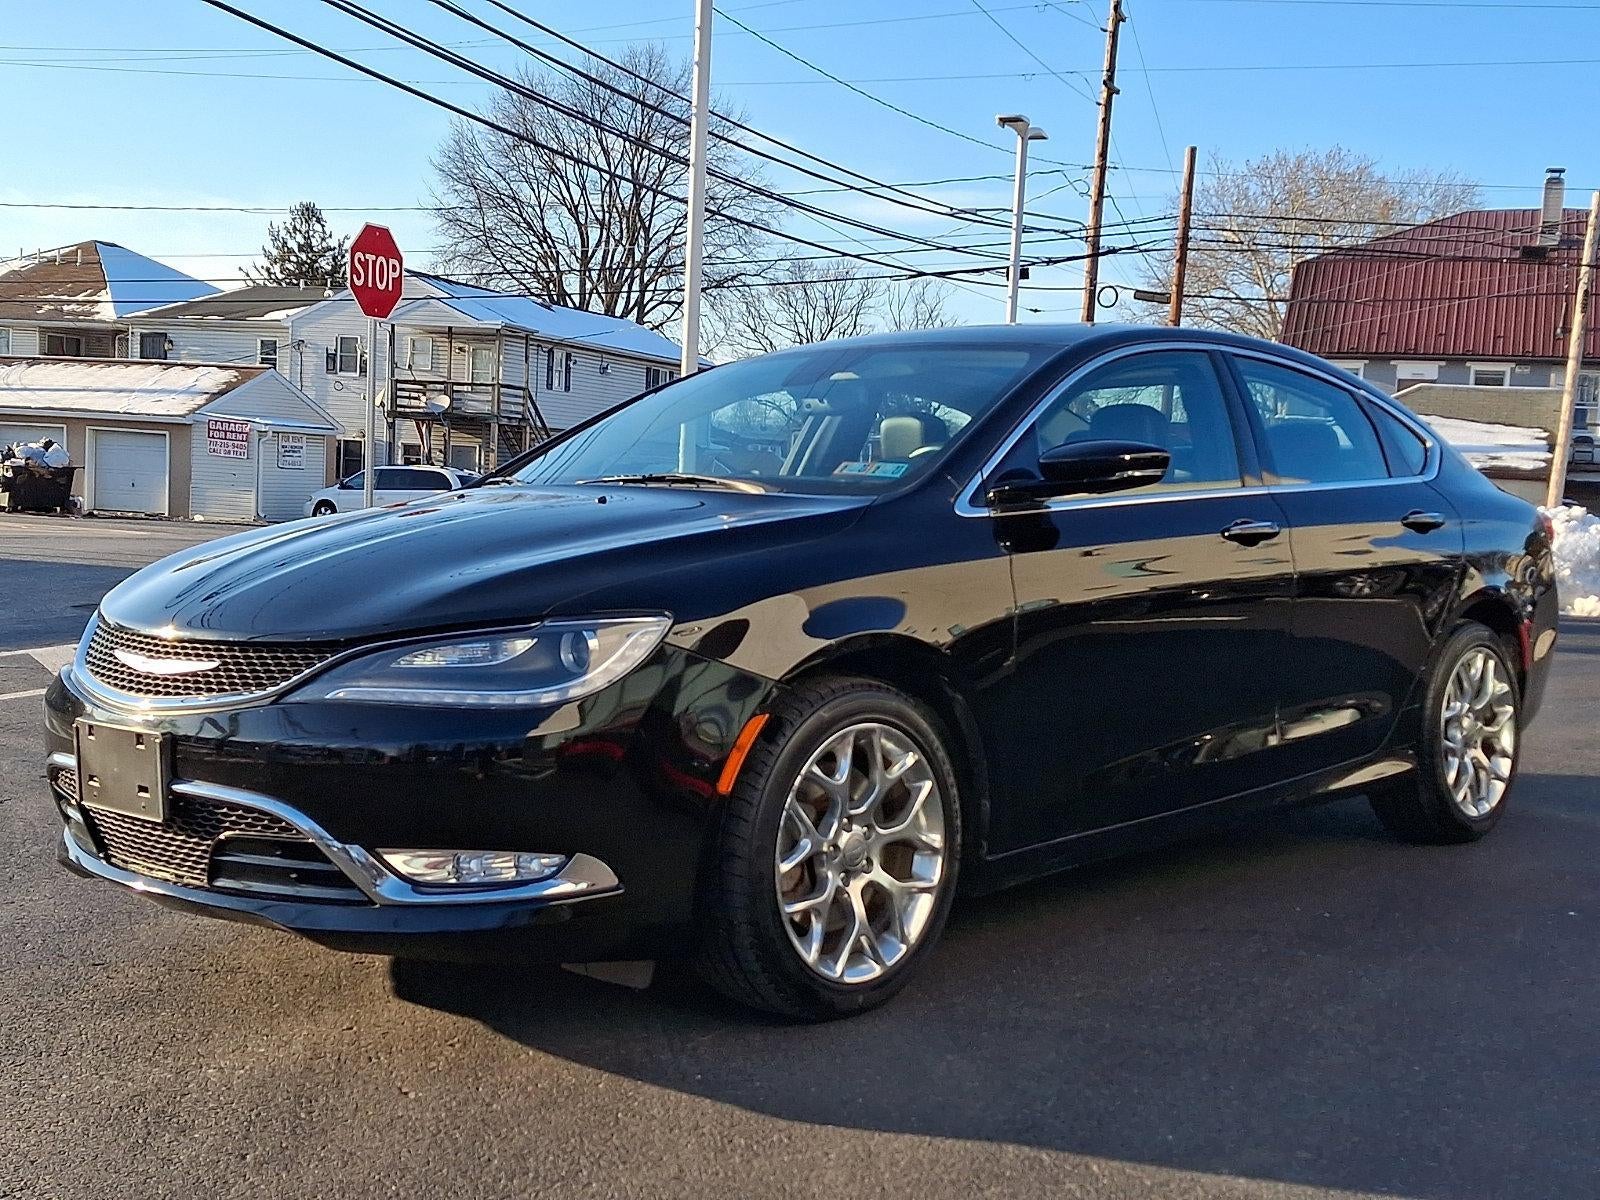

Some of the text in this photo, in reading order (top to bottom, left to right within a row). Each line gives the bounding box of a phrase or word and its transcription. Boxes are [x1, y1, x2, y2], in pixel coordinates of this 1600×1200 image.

[353, 252, 400, 291] STOP
[209, 420, 249, 433] GARAGE
[209, 430, 248, 441] FOR RENT
